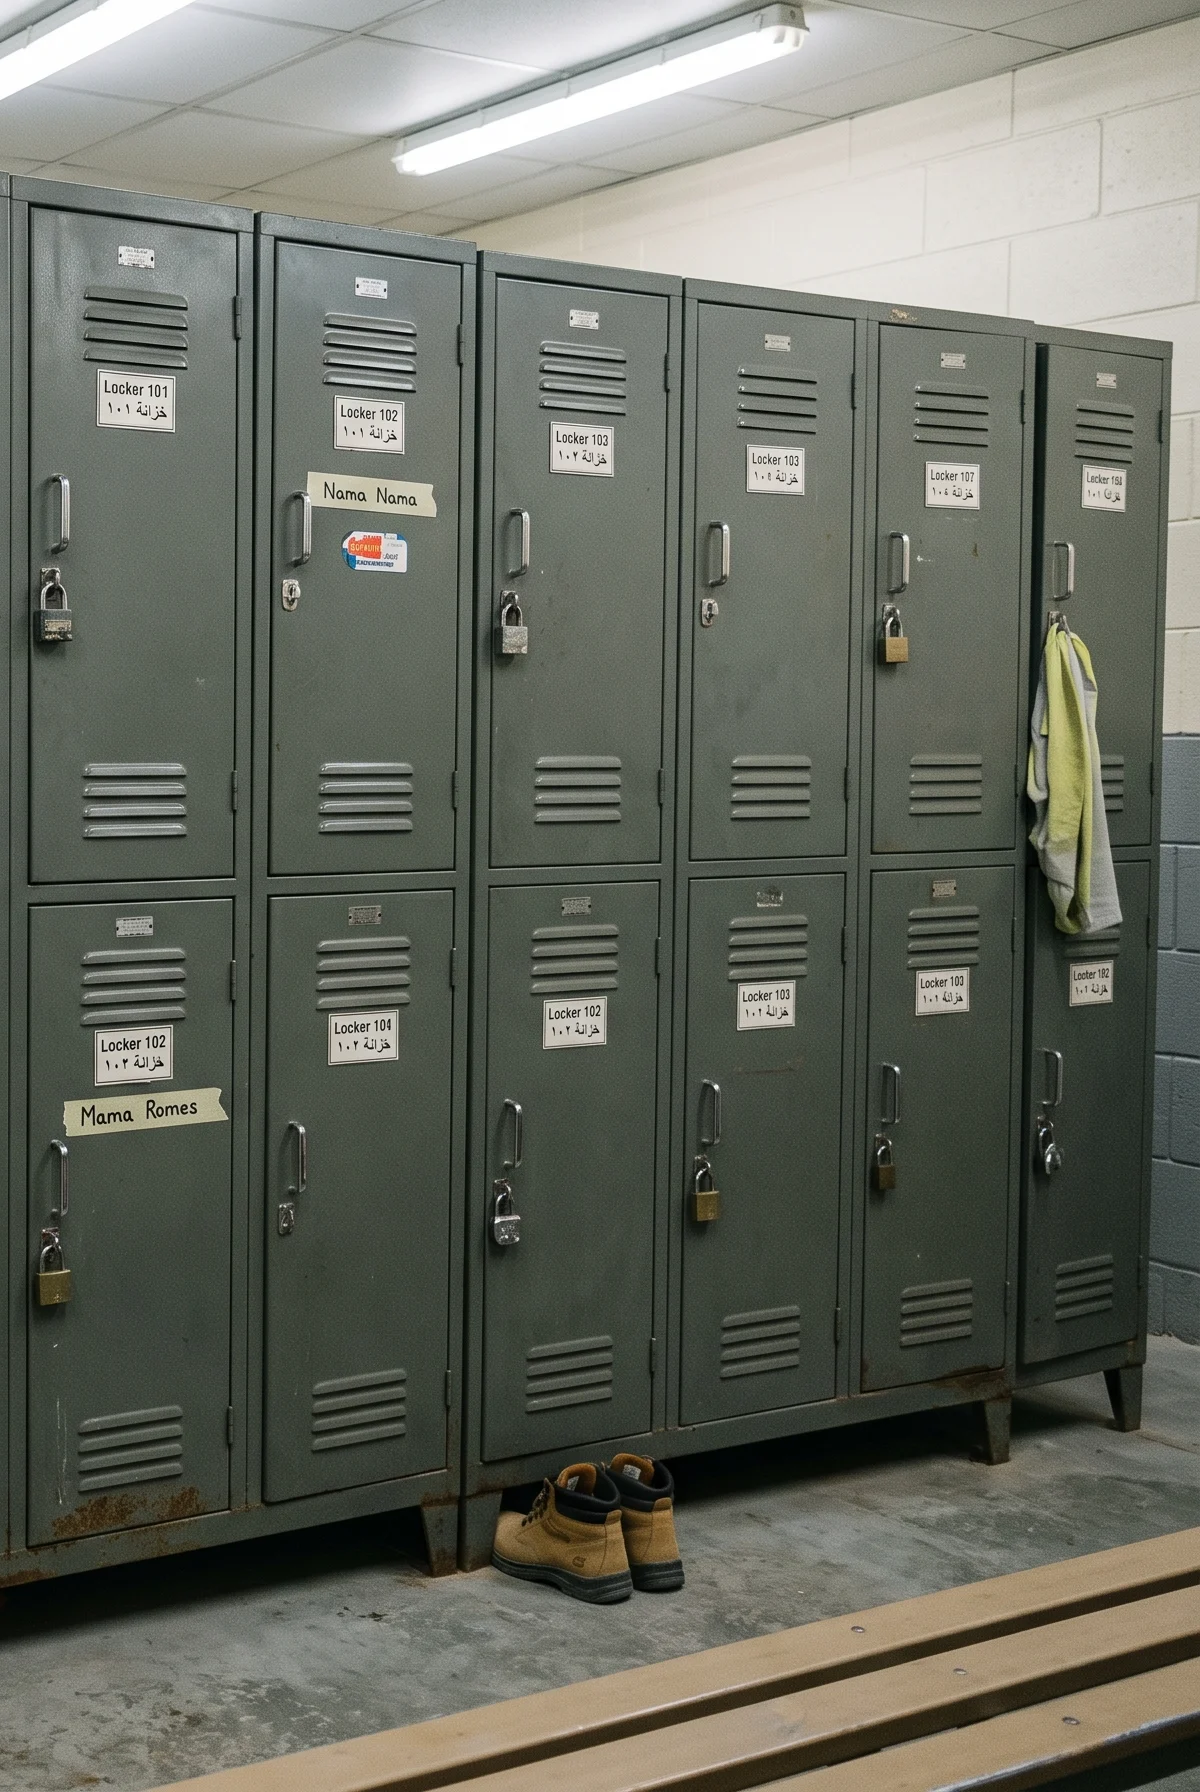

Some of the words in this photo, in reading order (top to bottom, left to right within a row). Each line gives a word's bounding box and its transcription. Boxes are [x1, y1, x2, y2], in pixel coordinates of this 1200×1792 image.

[104, 380, 144, 396] Locker
[148, 384, 168, 398] 101
[108, 402, 130, 414] ١٠١
[136, 401, 167, 421] خزانة
[340, 404, 376, 420] Locker
[379, 408, 398, 422] 102
[344, 425, 364, 438] ١٠١
[369, 425, 398, 443] خزانة
[556, 430, 589, 445] Locker
[592, 434, 609, 447] 103
[752, 452, 781, 465] Locker
[784, 455, 800, 467] 103
[930, 469, 958, 481] Locker
[324, 481, 367, 502] Nama
[376, 486, 418, 506] Nama
[920, 976, 948, 989] Locker
[742, 990, 773, 1003] Locker
[775, 988, 790, 1001] 103
[548, 1007, 582, 1020] Locker
[584, 1004, 601, 1018] 102
[334, 1021, 371, 1035] Locker
[101, 1038, 142, 1052] Locker
[145, 1034, 166, 1049] 102
[81, 1105, 134, 1127] Mama
[146, 1099, 198, 1119] Romes
